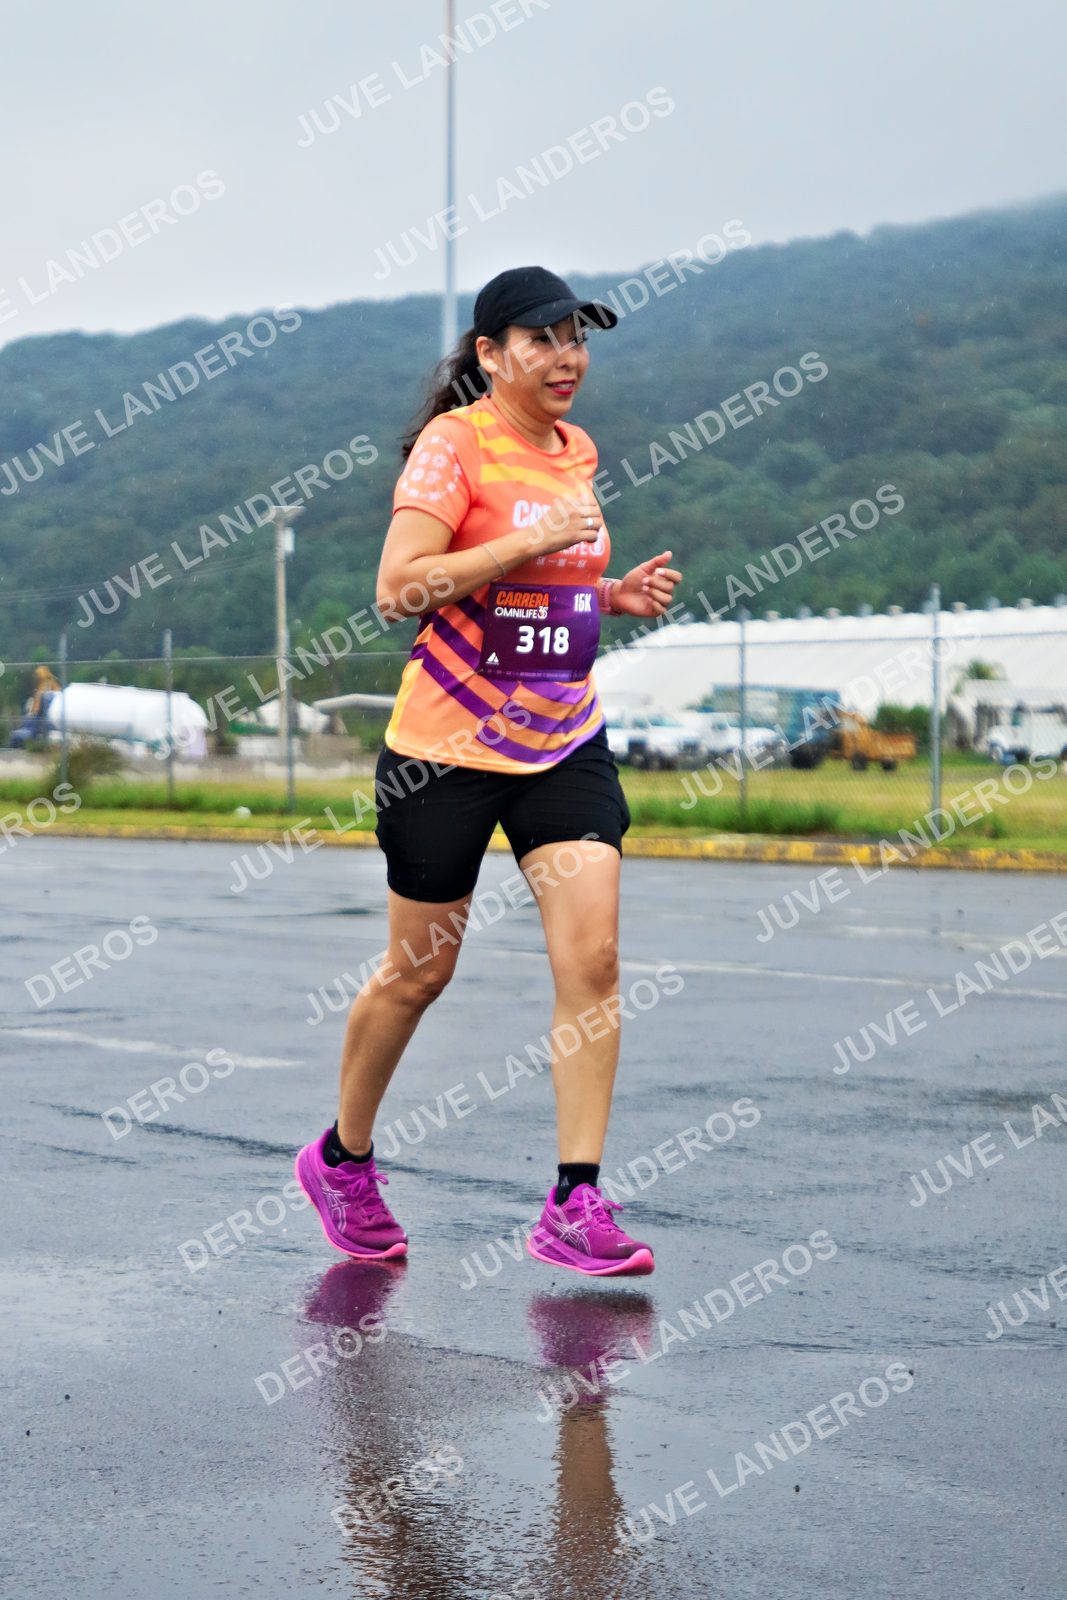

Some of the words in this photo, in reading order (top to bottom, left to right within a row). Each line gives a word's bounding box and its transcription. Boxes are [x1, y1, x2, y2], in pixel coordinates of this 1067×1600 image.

[496, 590, 549, 608] CARRERA
[574, 593, 592, 612] 15K
[516, 625, 570, 654] 318
